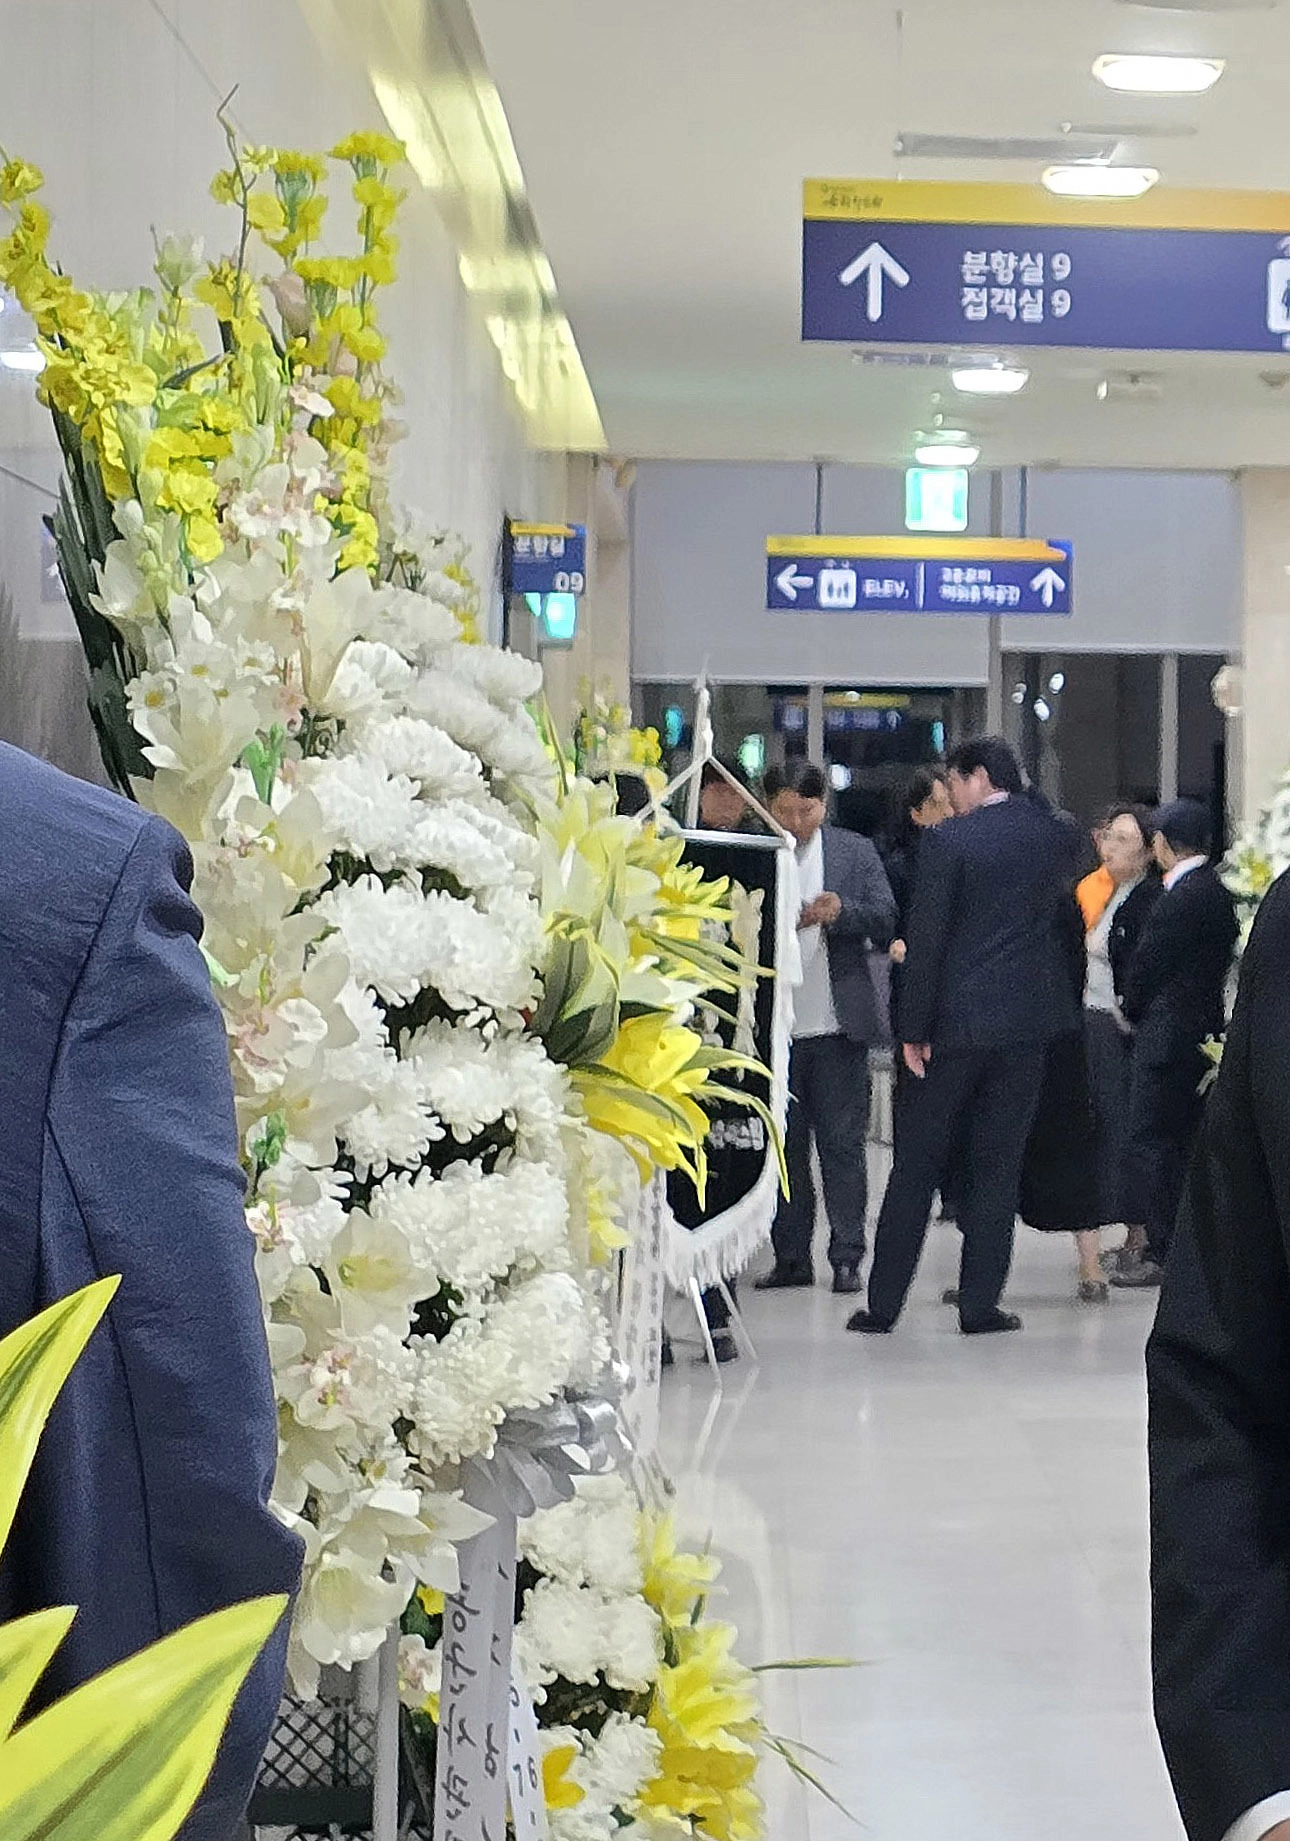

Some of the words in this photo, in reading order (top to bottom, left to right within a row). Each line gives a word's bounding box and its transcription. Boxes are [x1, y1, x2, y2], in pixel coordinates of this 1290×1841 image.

[960, 250, 1045, 286] 분향실
[1051, 252, 1072, 282] 9
[960, 286, 1045, 323] 접객실
[1051, 289, 1072, 319] 9
[554, 571, 584, 593] 09
